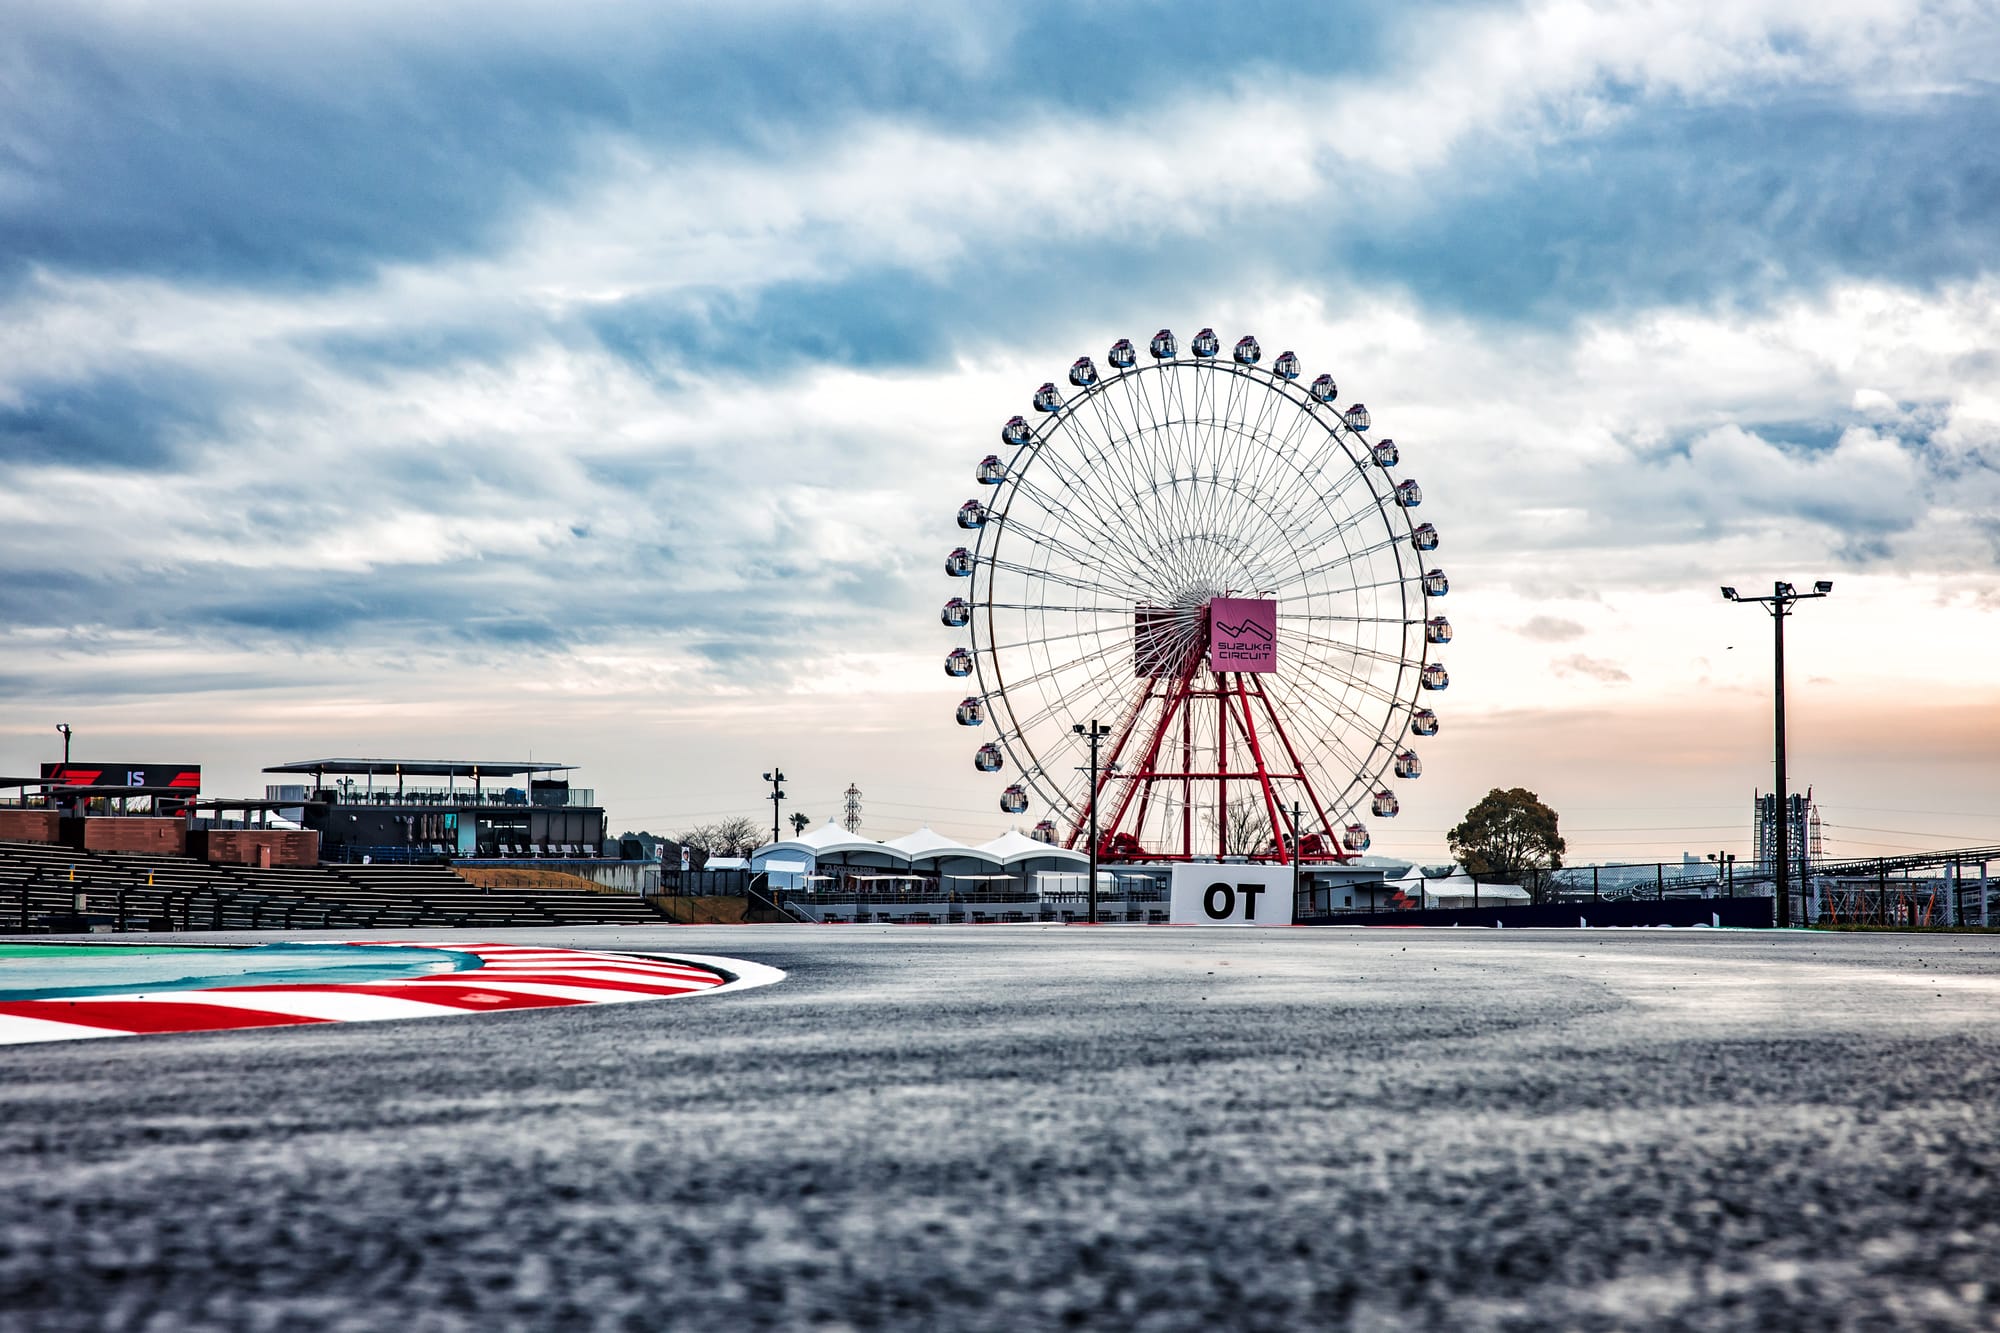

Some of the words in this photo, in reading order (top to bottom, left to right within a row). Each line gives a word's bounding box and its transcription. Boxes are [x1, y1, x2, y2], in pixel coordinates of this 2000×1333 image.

[1217, 642, 1272, 651] SUZUKA
[1219, 651, 1270, 660] CIRCUIT
[127, 771, 145, 786] IS
[1203, 882, 1265, 920] OT
